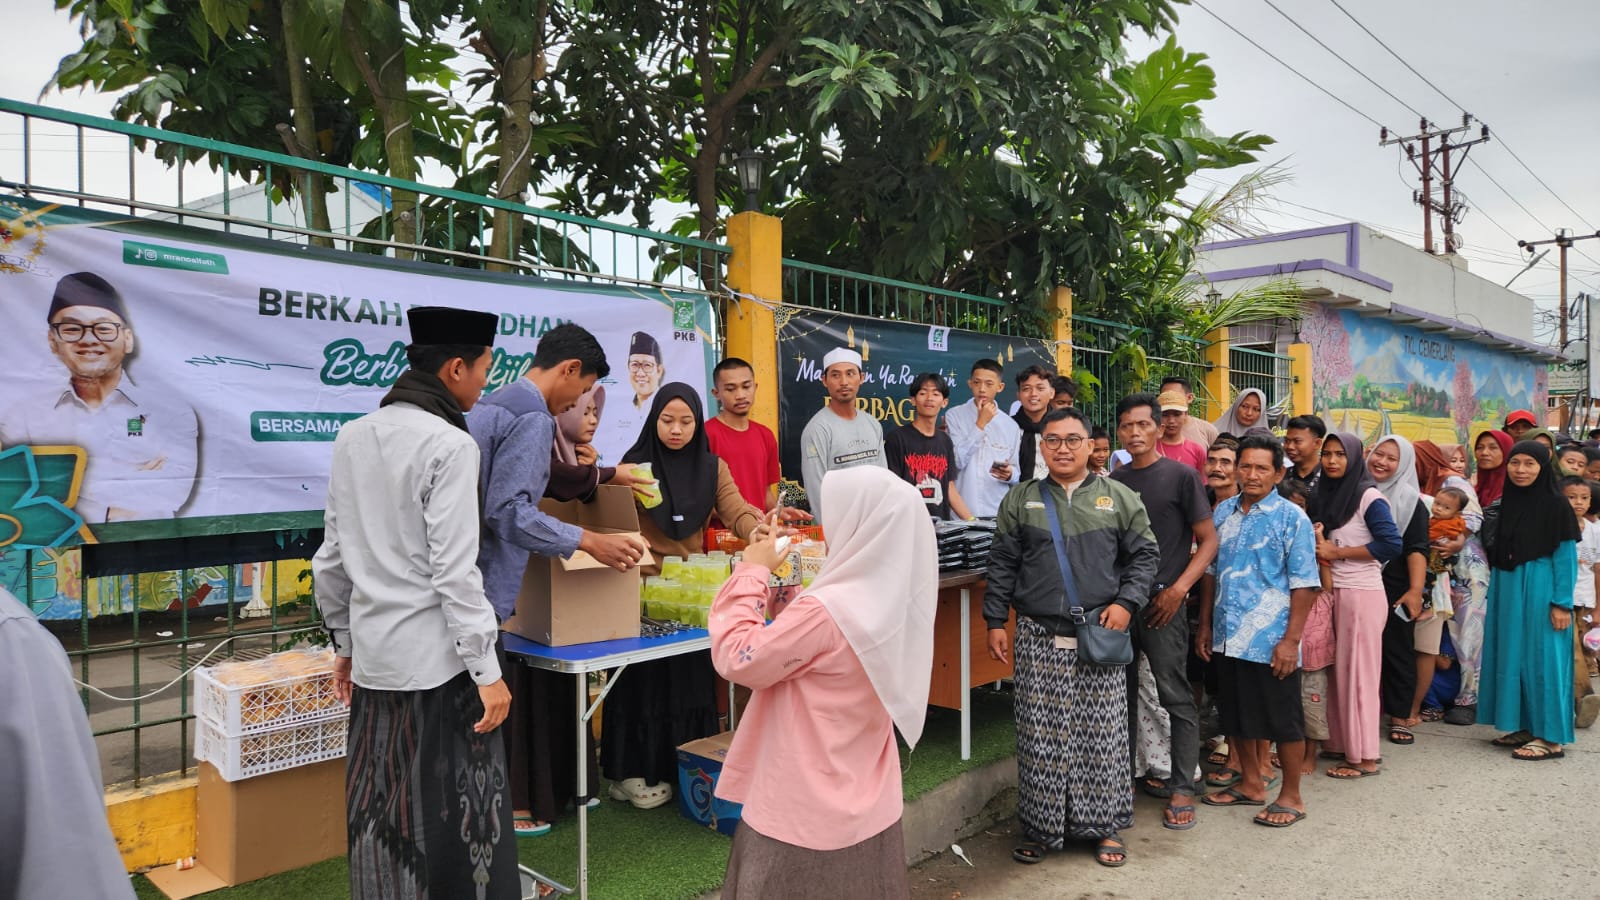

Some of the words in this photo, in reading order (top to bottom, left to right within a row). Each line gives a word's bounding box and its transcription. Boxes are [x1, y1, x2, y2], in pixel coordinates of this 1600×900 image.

[259, 287, 403, 326] BERKAH
[674, 331, 696, 341] PKB
[879, 364, 897, 390] Ya
[259, 418, 343, 433] BERSAMA
